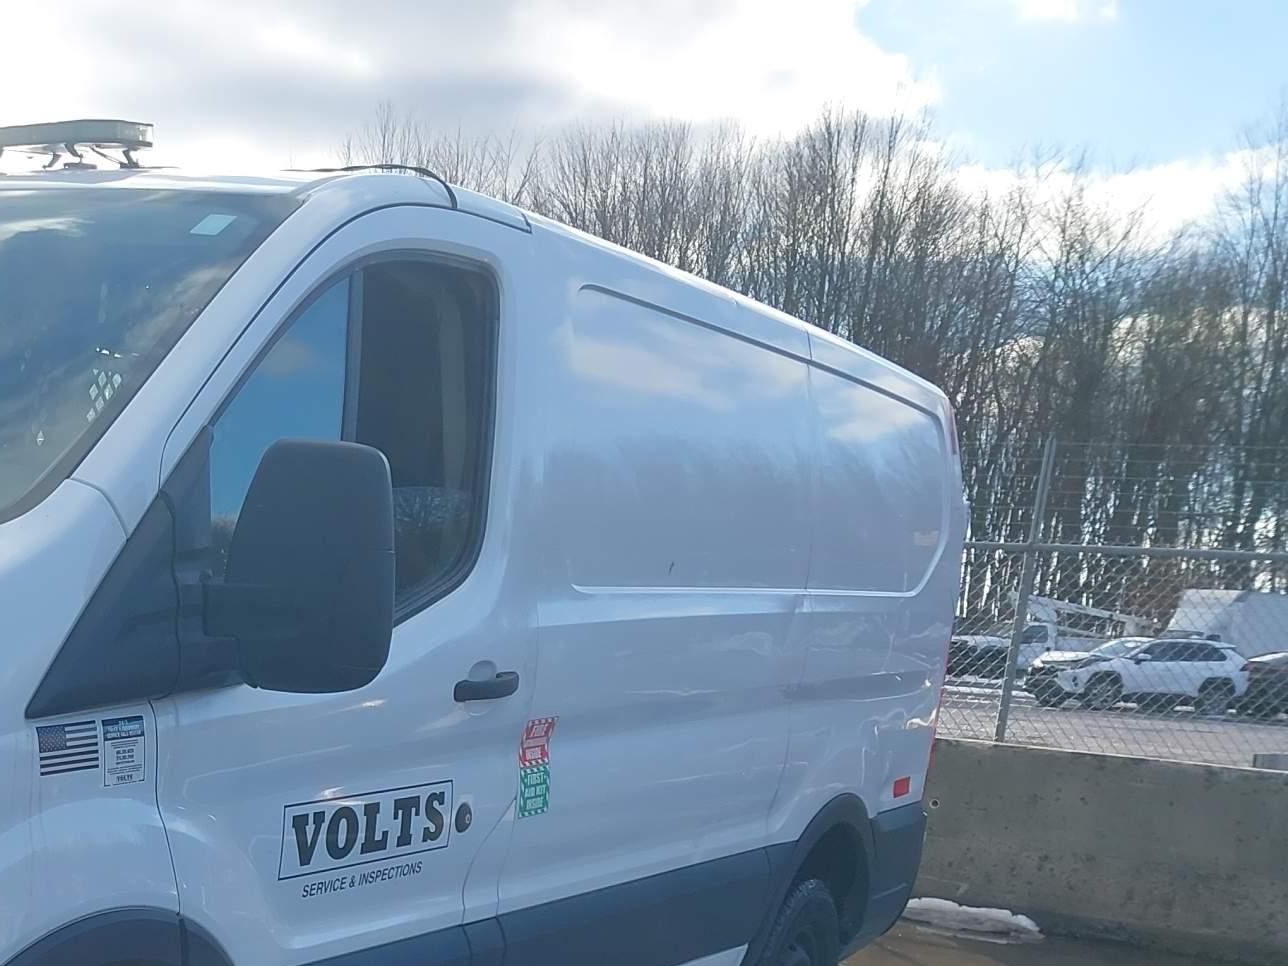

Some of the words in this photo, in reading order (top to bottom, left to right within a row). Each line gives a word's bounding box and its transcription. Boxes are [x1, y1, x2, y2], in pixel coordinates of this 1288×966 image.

[524, 786, 536, 798] AID
[527, 772, 545, 786] FIRST
[292, 791, 445, 867] VOLTS
[301, 876, 347, 899] SERVICE
[348, 874, 356, 888] &
[358, 860, 423, 886] INSPECTIONS
